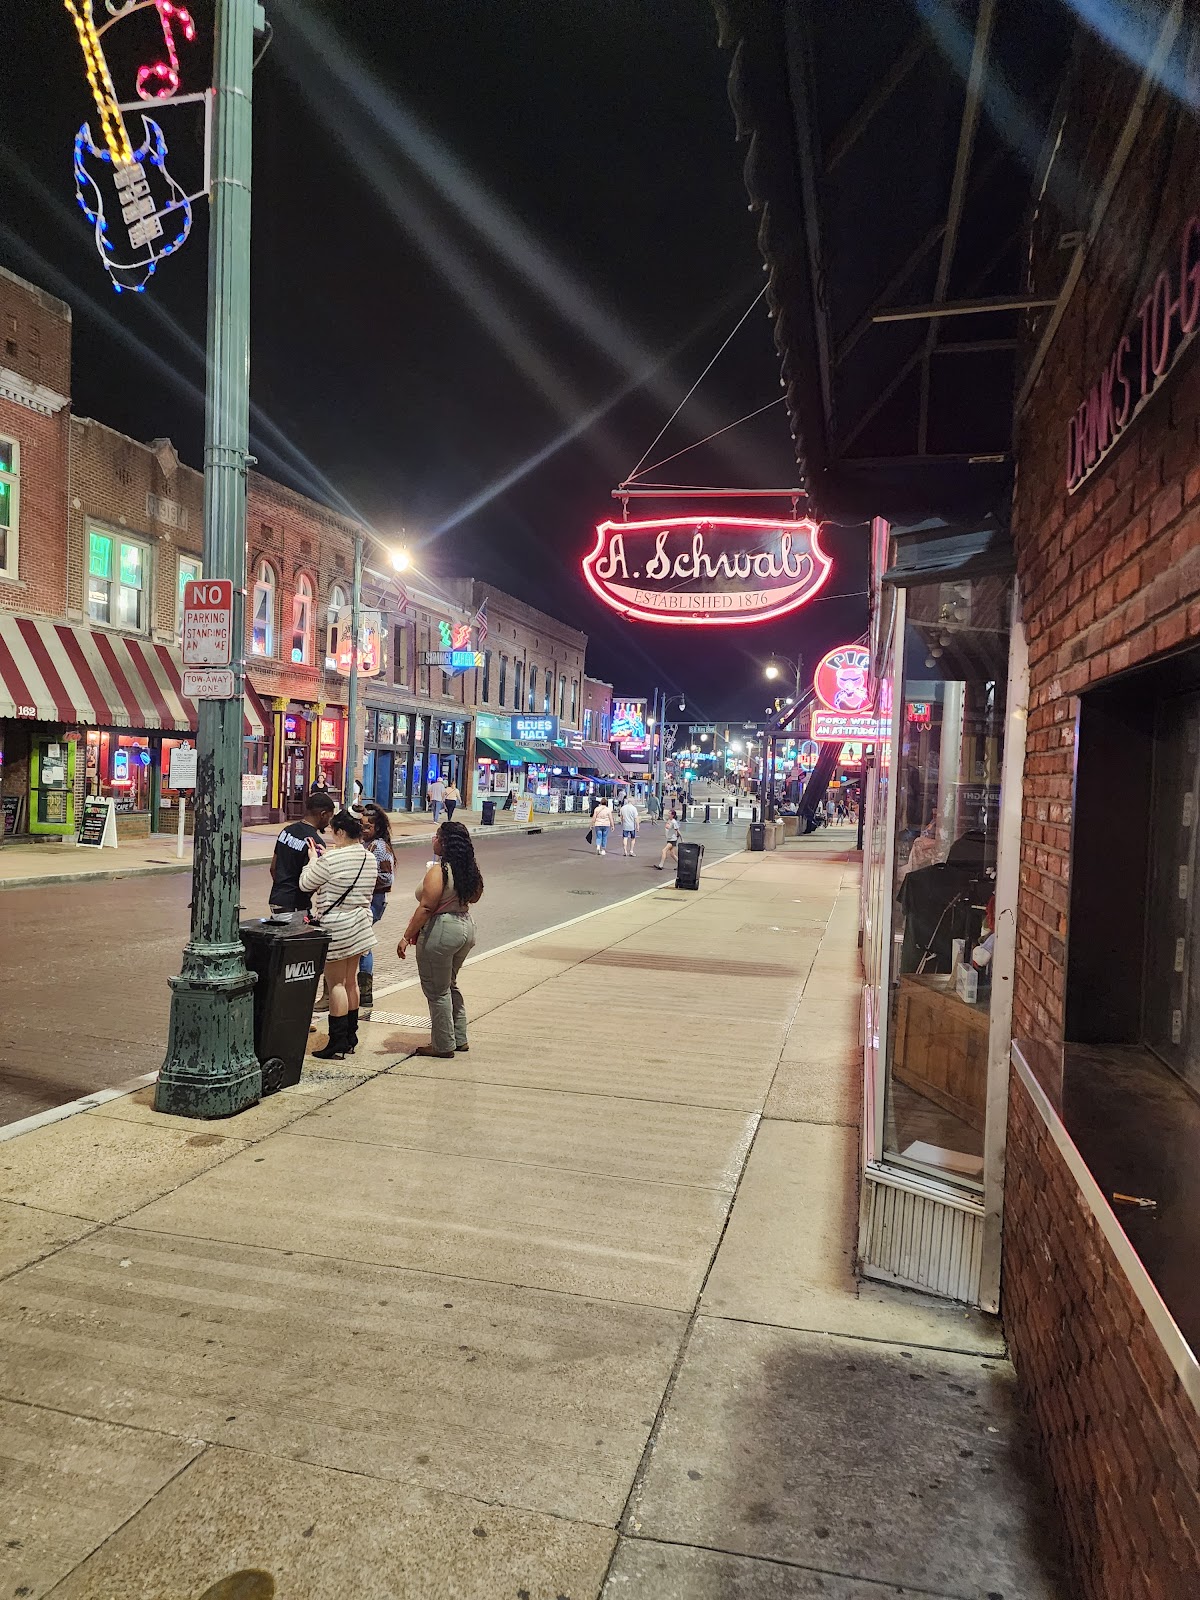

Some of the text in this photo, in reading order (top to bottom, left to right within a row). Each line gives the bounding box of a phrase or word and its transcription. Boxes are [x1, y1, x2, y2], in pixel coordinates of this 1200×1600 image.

[596, 530, 814, 580] A. Schwab
[193, 585, 223, 605] NO
[634, 590, 768, 608] ESTABLISHED 1876
[187, 612, 226, 624] PARKING
[186, 675, 229, 683] TOW-AWAY
[196, 684, 219, 693] ZONE
[18, 705, 36, 717] 162
[517, 720, 553, 731] BLUES
[817, 716, 848, 725] PORK
[520, 730, 548, 740] HALL
[816, 726, 830, 735] AN
